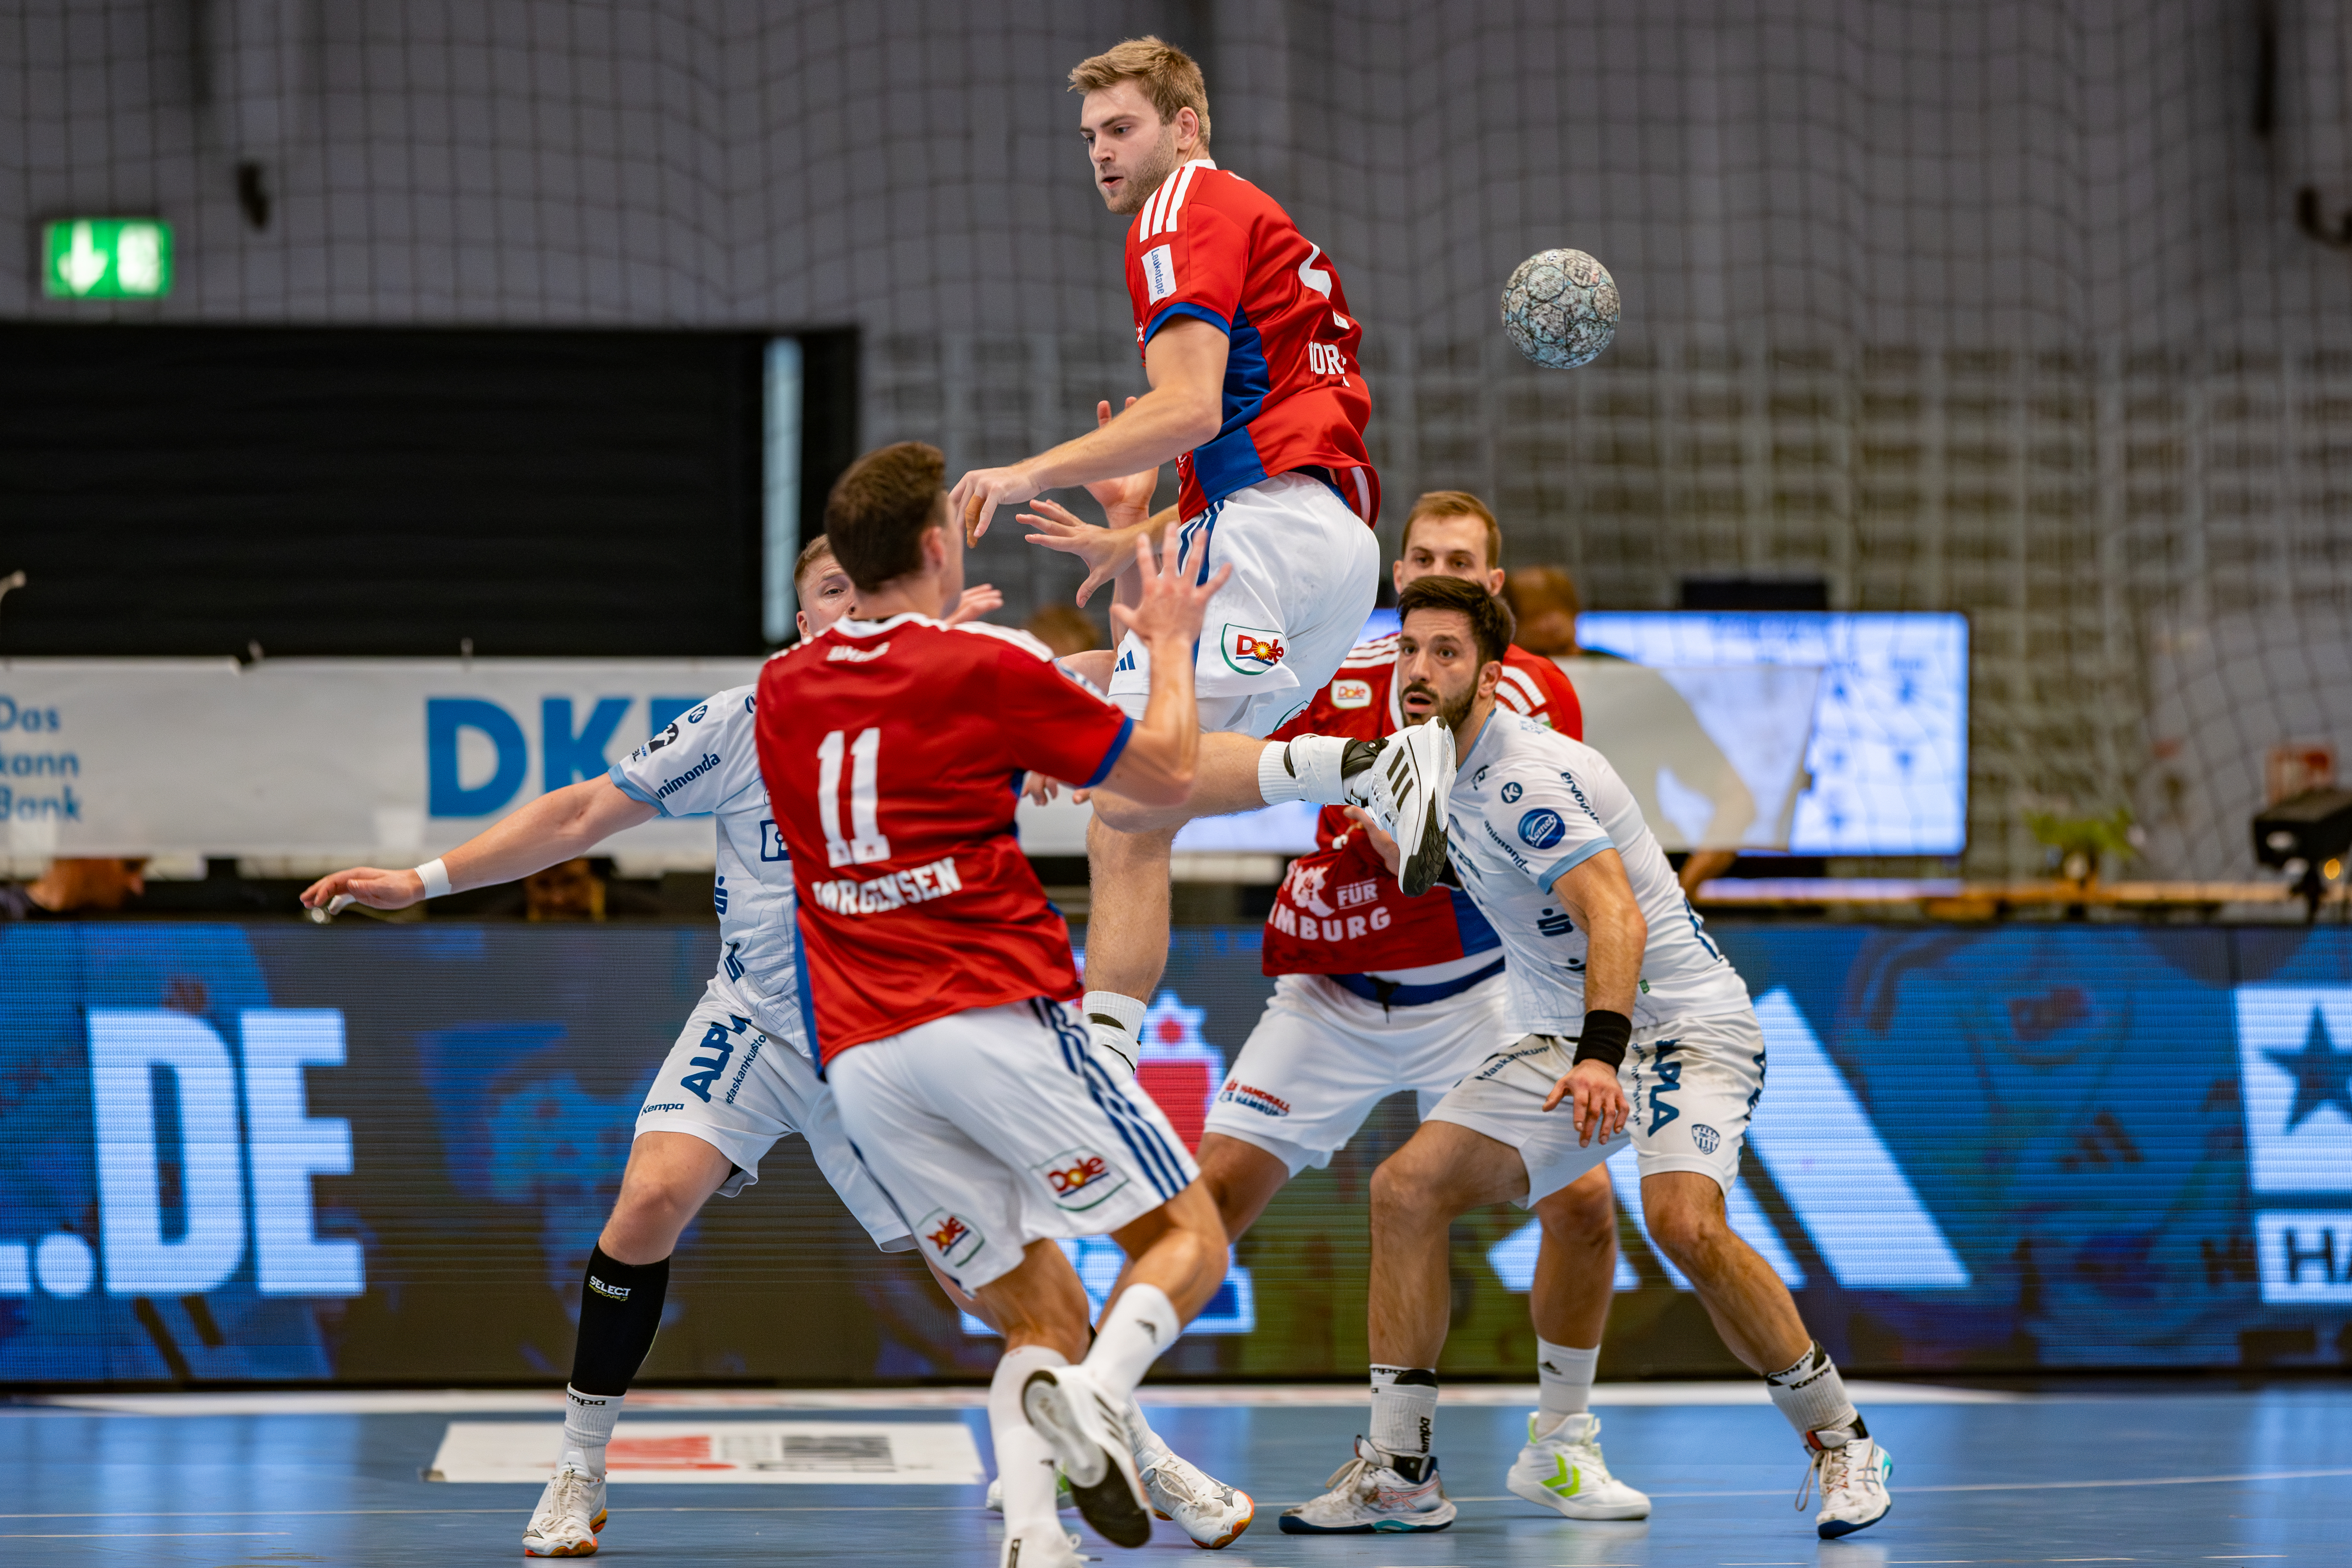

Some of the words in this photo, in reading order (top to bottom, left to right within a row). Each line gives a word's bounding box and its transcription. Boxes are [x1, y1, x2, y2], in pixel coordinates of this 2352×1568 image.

[1151, 248, 1164, 294] Leukotape
[1236, 634, 1284, 664] Dole
[1338, 686, 1366, 698] Dole
[426, 696, 717, 819] DK
[817, 727, 891, 868] 11
[1484, 820, 1530, 874] animond
[1337, 882, 1378, 907] FÜR
[641, 1103, 685, 1116] Kempa
[590, 1275, 631, 1296] SELECT
[568, 1393, 606, 1405] mpa
